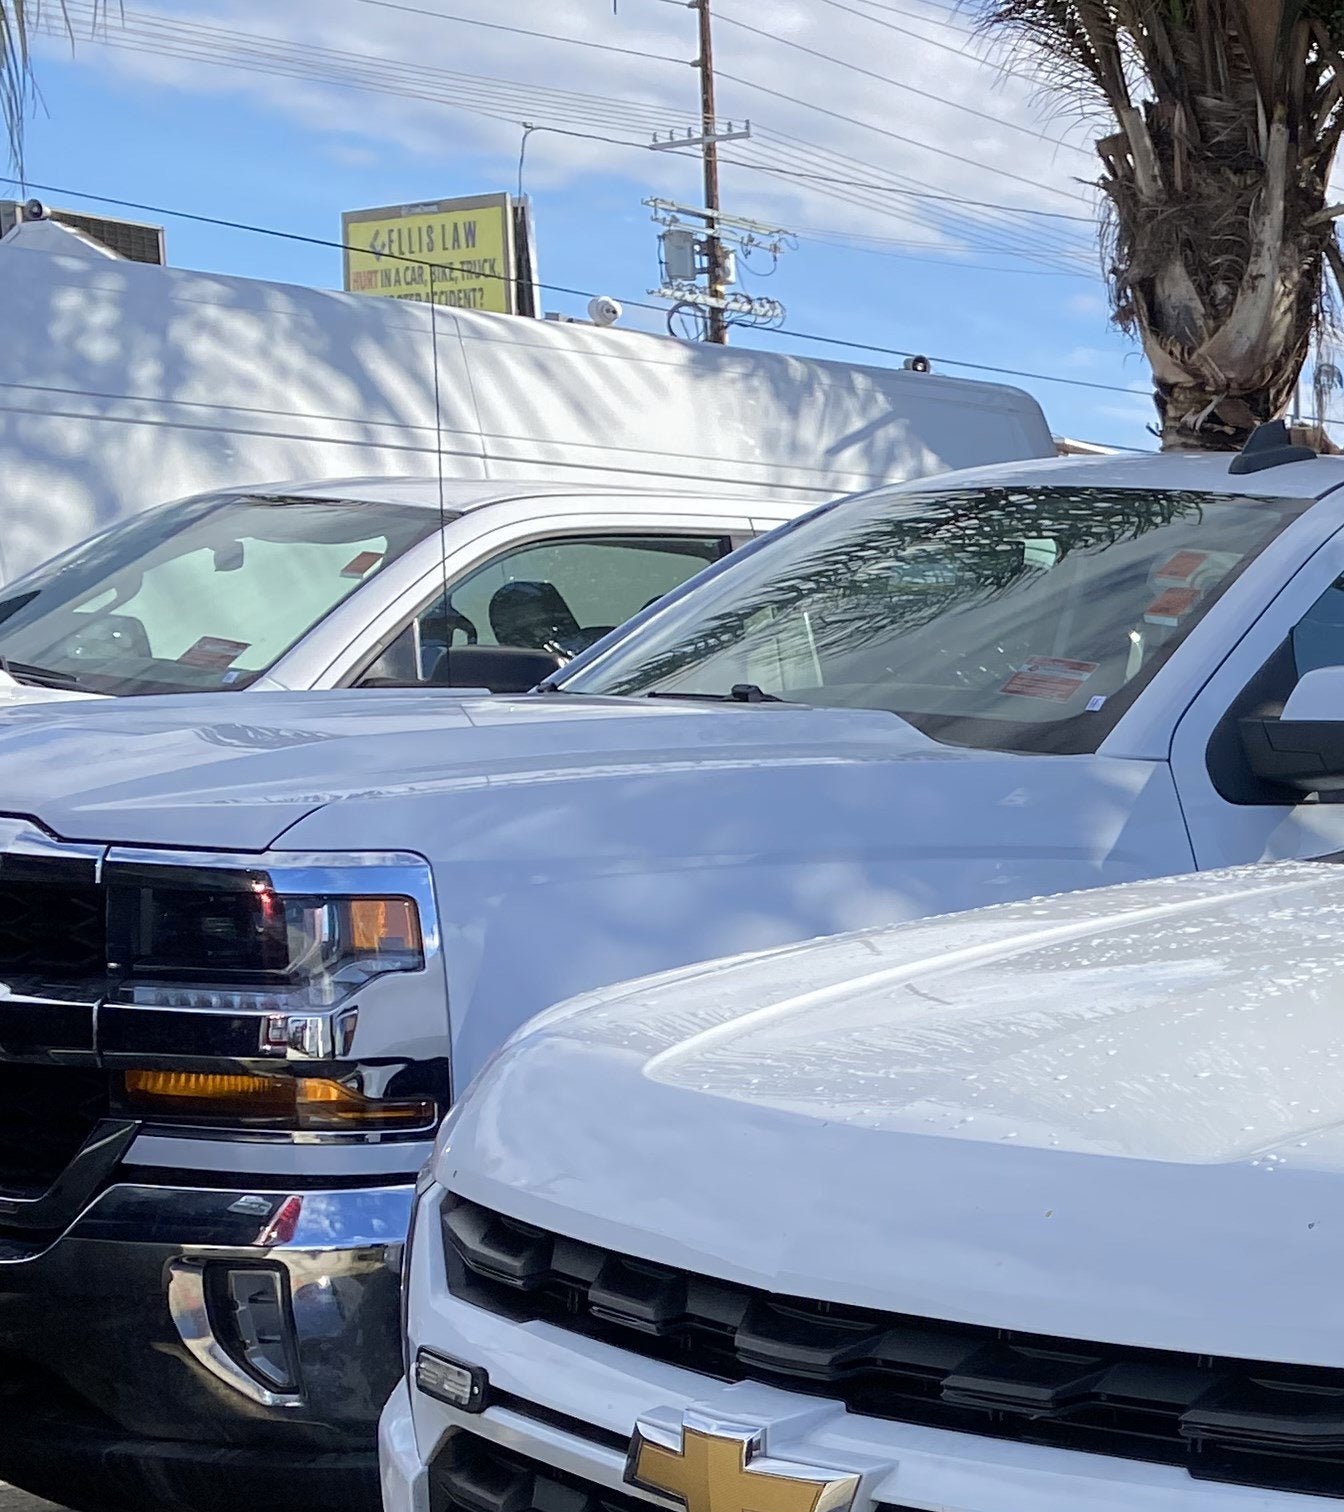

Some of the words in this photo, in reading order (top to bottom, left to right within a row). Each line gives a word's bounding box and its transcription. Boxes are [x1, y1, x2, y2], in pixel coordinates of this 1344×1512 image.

[387, 224, 435, 256] ELLIS
[441, 220, 477, 251] LAW
[380, 267, 392, 288] IN
[393, 266, 402, 287] A
